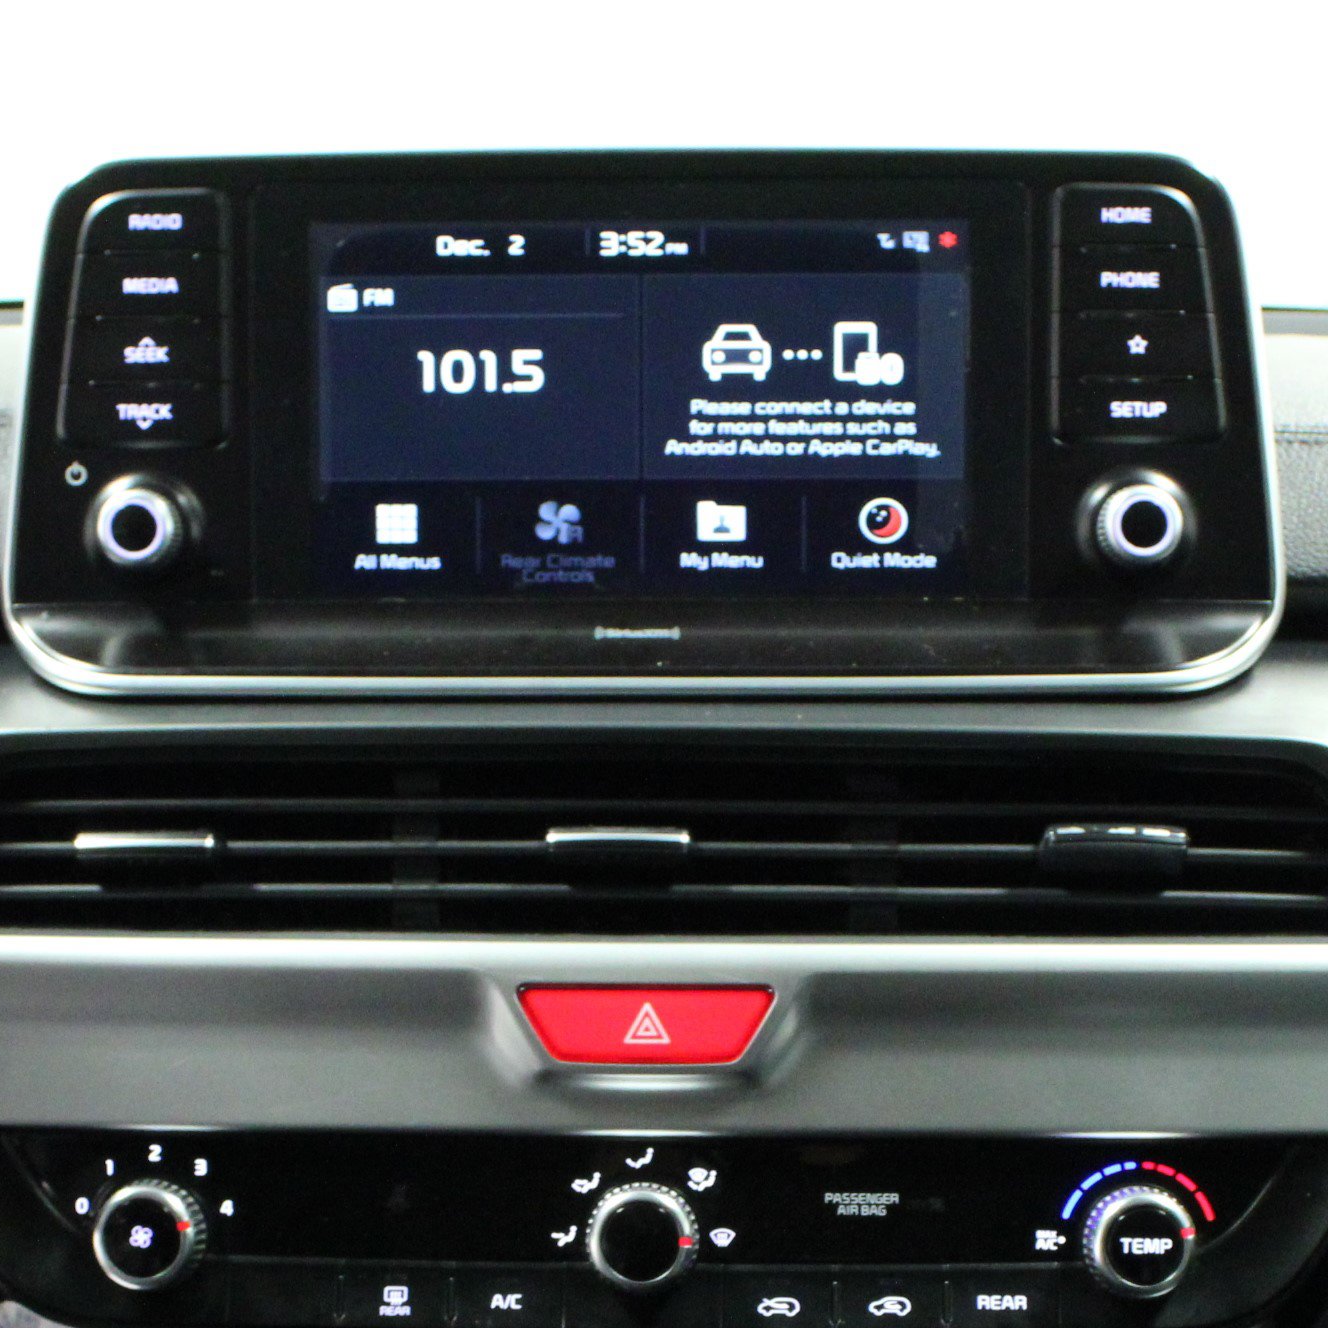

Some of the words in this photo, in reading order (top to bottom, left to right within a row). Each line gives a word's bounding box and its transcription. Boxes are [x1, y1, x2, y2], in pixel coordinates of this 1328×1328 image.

[127, 213, 184, 231] RADIO
[1100, 206, 1152, 224] HOME
[435, 235, 491, 257] Dec.
[507, 234, 526, 256] 2
[122, 277, 179, 295] MEDIA
[1099, 271, 1161, 288] PHONE
[363, 288, 394, 306] FM
[123, 346, 171, 364] SEEK
[416, 348, 546, 394] 101.5
[115, 403, 173, 421] TRACK
[689, 398, 752, 416] Please
[754, 399, 833, 416] connect
[834, 402, 850, 416] a
[851, 399, 916, 416] device
[1109, 401, 1168, 418] SETUP
[688, 419, 716, 436] for
[717, 422, 766, 436] more
[767, 419, 844, 436] features
[845, 419, 891, 436] such
[893, 422, 917, 436] as
[664, 438, 738, 456] Android
[739, 439, 785, 456] Auto
[785, 442, 807, 456] or
[807, 438, 864, 458] Apple
[865, 438, 942, 459] CarPlay.
[354, 554, 377, 570] All
[379, 554, 442, 570] Menus
[679, 552, 709, 571] My
[711, 552, 764, 569] Menu
[830, 552, 882, 570] Quiet
[883, 552, 938, 569] Mode
[148, 1144, 162, 1163] 2
[104, 1159, 115, 1177] 1
[193, 1158, 209, 1177] 3
[824, 1192, 900, 1205] PASSENGER
[219, 1199, 234, 1217] 4
[837, 1206, 859, 1216] AIR
[860, 1206, 887, 1217] BAG
[1035, 1239, 1058, 1250] A/C
[1120, 1237, 1174, 1255] TEMP
[379, 1306, 411, 1316] REAR
[490, 1294, 523, 1310] A/C
[976, 1295, 1028, 1311] REAR
